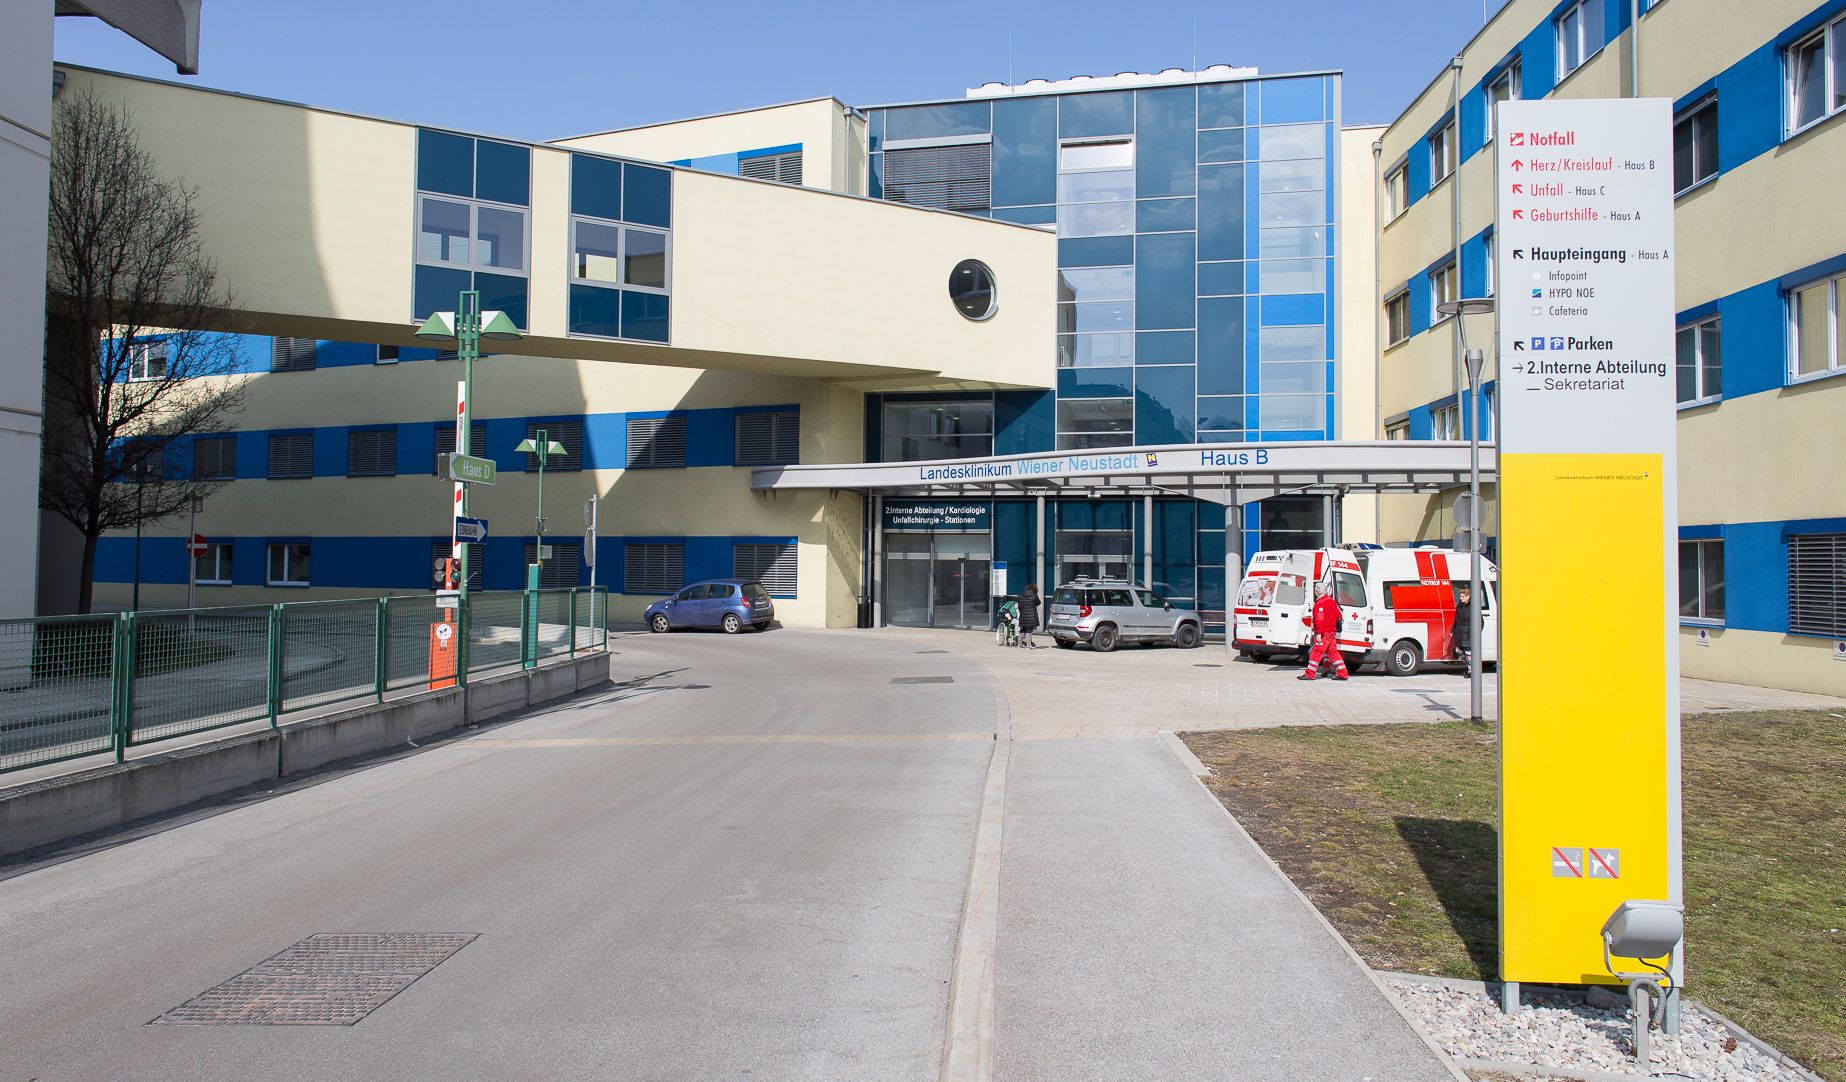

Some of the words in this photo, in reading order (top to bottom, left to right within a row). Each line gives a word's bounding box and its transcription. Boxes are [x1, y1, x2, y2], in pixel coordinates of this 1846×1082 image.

[1529, 131, 1575, 146] Notfall
[1530, 157, 1613, 172] Herz/Kreislauf
[1624, 160, 1646, 170] Haus
[1649, 160, 1655, 170] B
[1530, 183, 1564, 197] Unfall
[1575, 186, 1597, 196] Haus
[1600, 186, 1606, 196] C
[1530, 208, 1599, 222] Geburtshilfe
[1610, 211, 1632, 221] Haus
[1634, 211, 1641, 221] A
[1531, 247, 1627, 264] Haupteingang
[1638, 250, 1660, 260] Haus
[1662, 250, 1669, 260] A
[1549, 271, 1588, 282] Infopoint
[1549, 288, 1573, 298] HYPO
[1576, 288, 1595, 298] NOE
[1549, 306, 1588, 316] Cafeteria
[1568, 336, 1613, 350] Parken
[1527, 360, 1592, 374] 2.Interne
[1596, 360, 1667, 377] Abteilung
[1544, 378, 1625, 391] Sekretariat
[1201, 450, 1249, 466] Haus
[1256, 449, 1268, 465] B
[463, 460, 482, 477] Haus
[484, 464, 490, 479] D
[920, 463, 1012, 480] Landesklinikum
[1017, 459, 1064, 475] Wiener
[1068, 453, 1138, 471] Neustadt
[914, 506, 944, 515] Abteilung
[949, 506, 986, 515] Kardiologie
[893, 516, 939, 525] Unfallchirurgie
[945, 516, 976, 524] Stationen
[459, 524, 478, 536] EINBAHN
